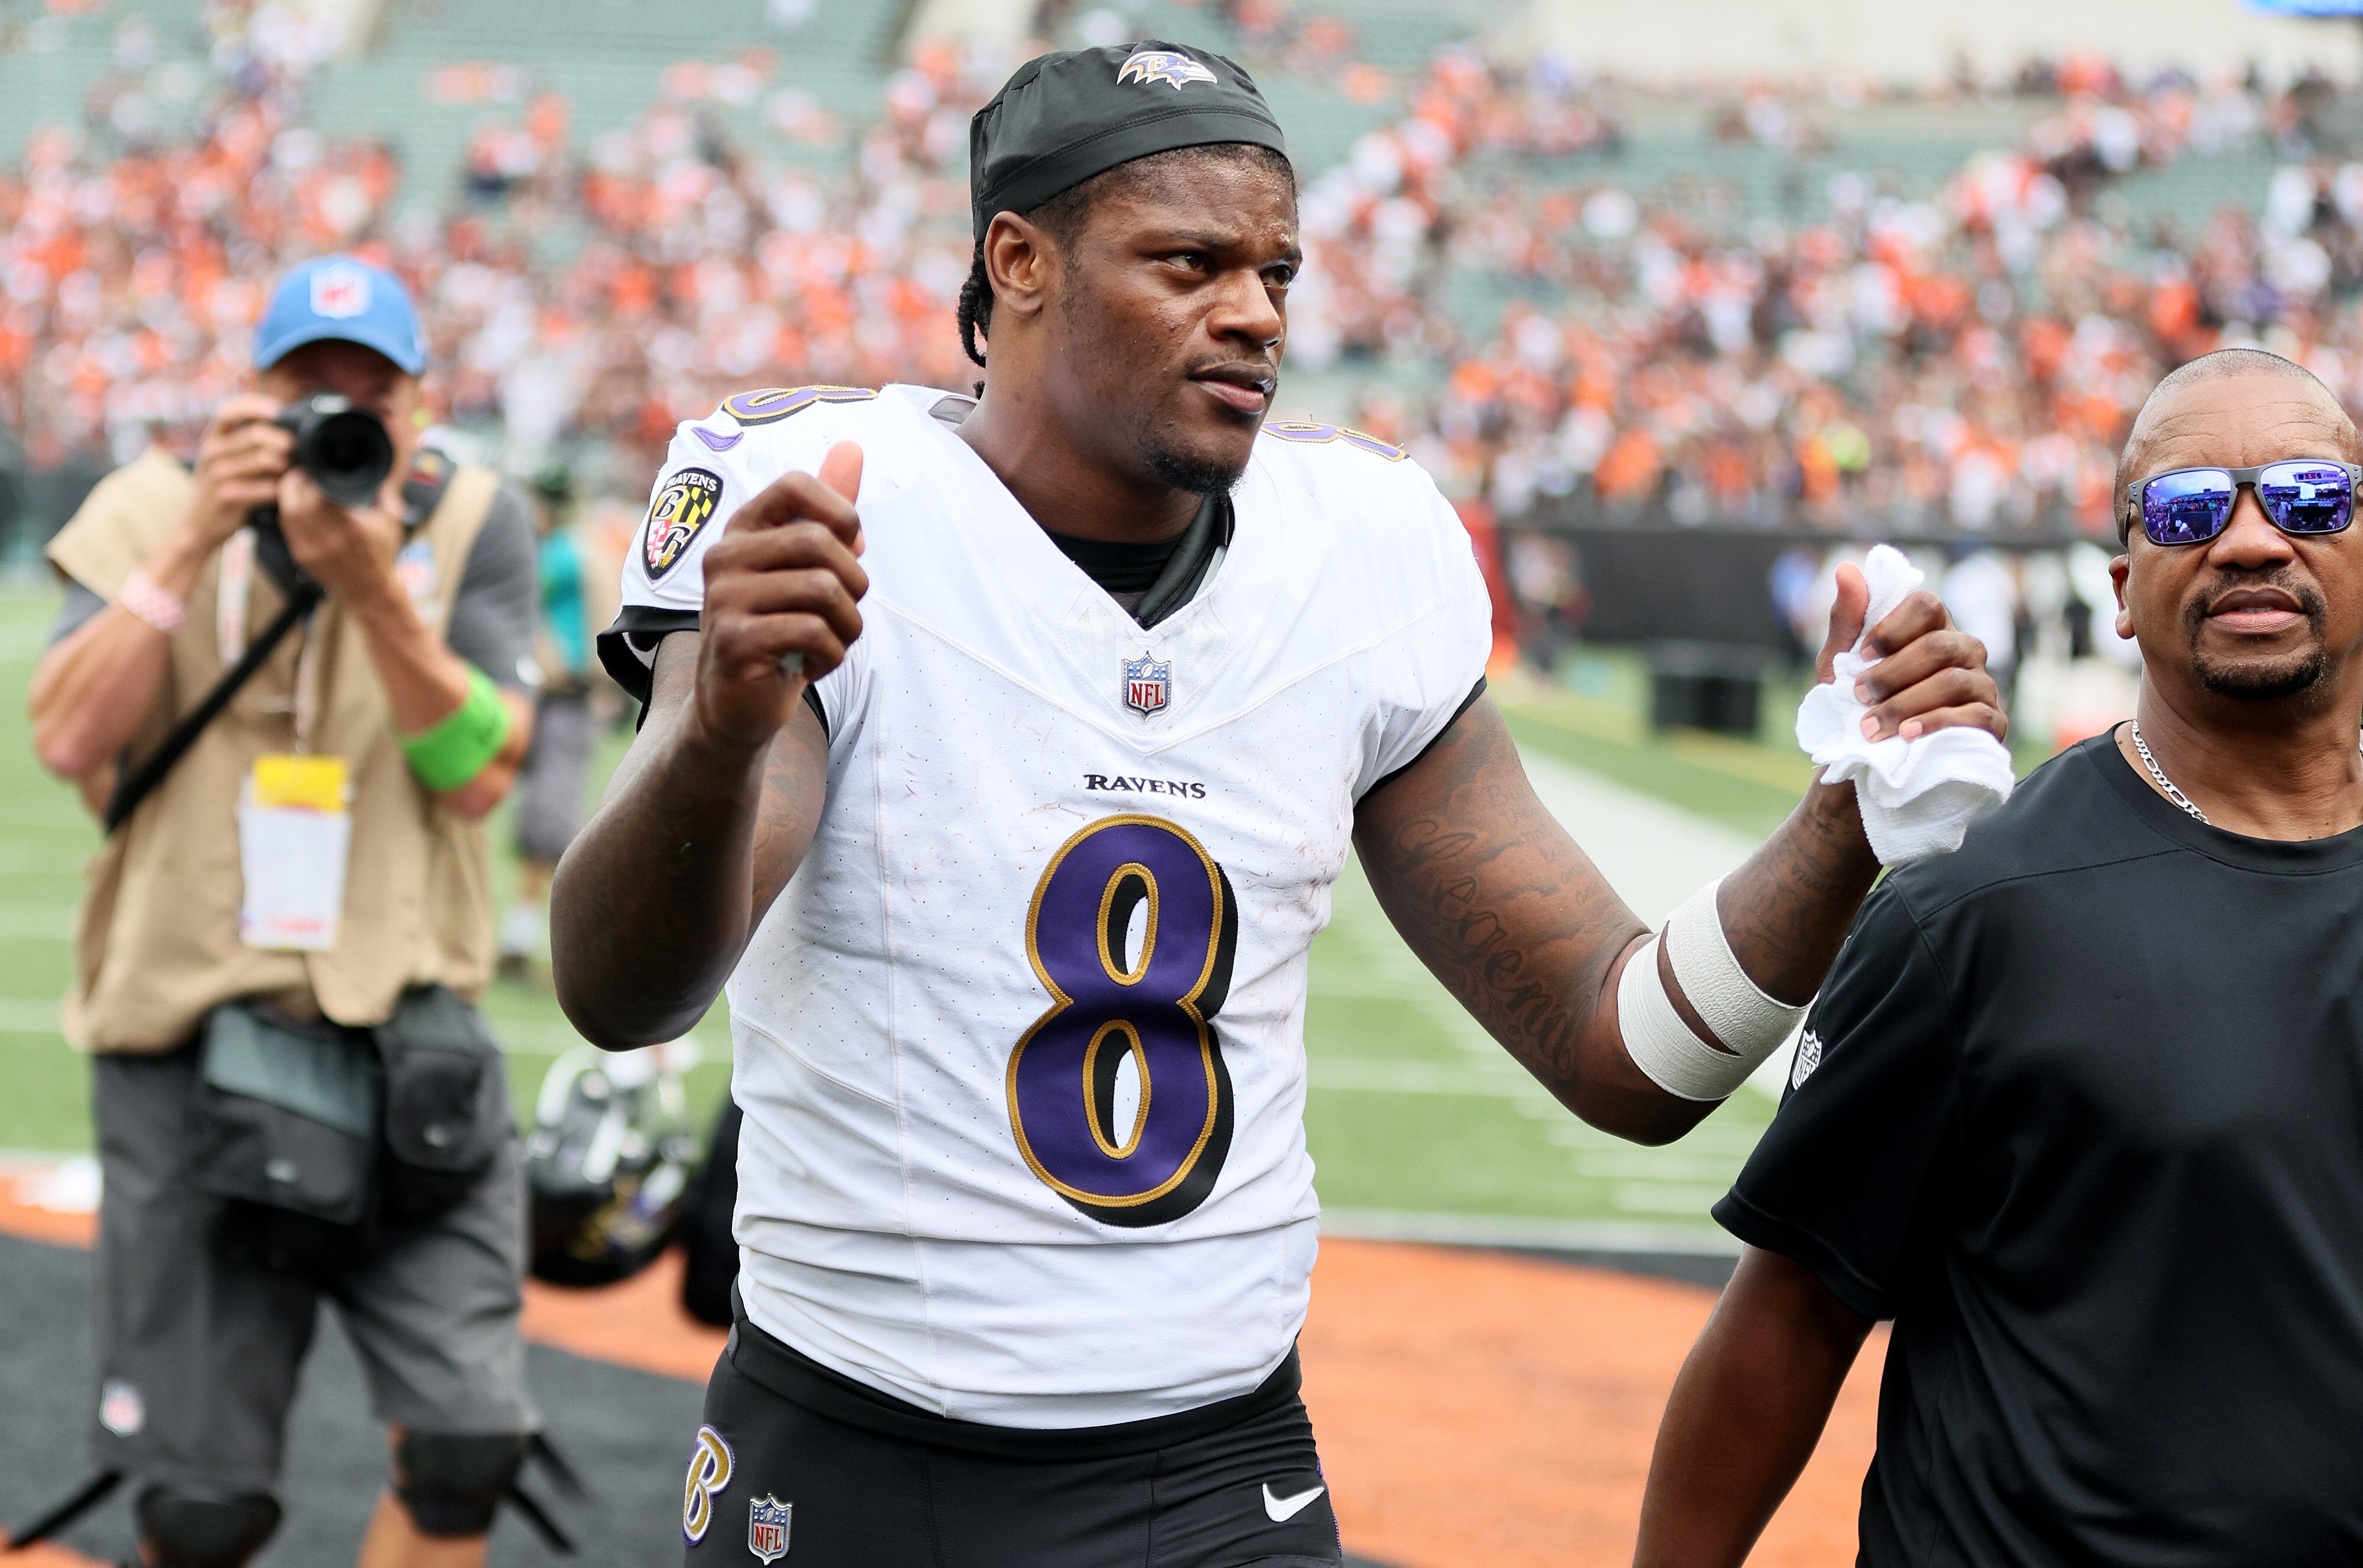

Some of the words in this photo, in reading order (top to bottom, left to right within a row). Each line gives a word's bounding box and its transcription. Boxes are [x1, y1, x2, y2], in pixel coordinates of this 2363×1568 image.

[665, 472, 718, 492] RAVENS
[653, 488, 686, 521] B
[1131, 683, 1164, 708] NFL
[1082, 774, 1206, 799] RAVENS
[1398, 819, 1575, 1074] Legend
[1007, 813, 1239, 1229] 8
[682, 1423, 736, 1547] B
[754, 1525, 782, 1553] NFL
